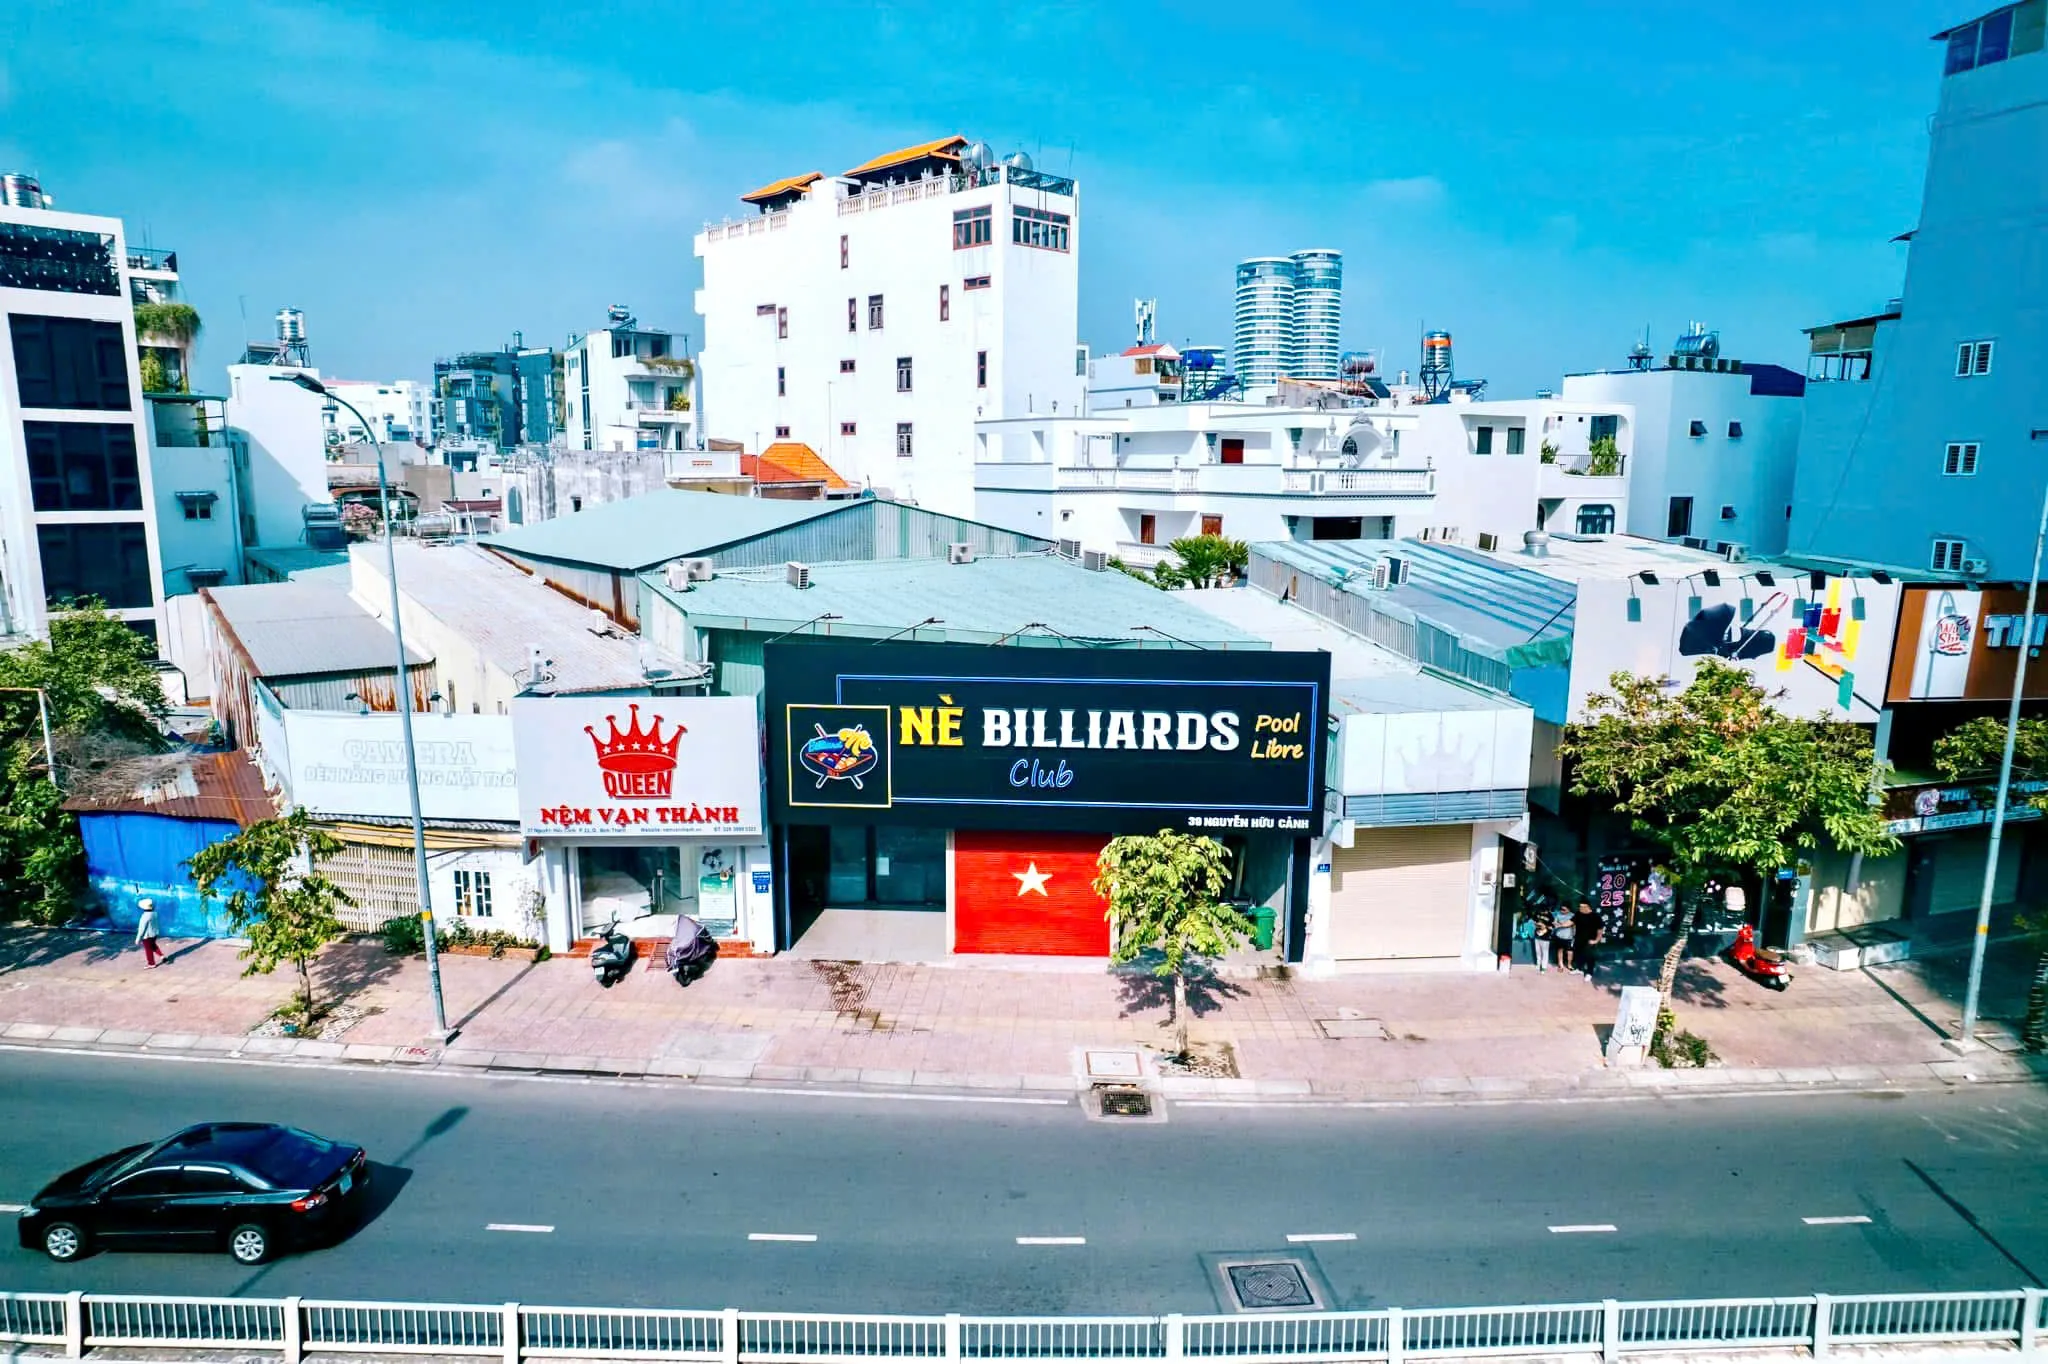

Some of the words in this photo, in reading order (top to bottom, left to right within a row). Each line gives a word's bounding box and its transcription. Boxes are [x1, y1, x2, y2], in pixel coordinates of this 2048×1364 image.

[899, 694, 965, 747] NÈ
[982, 707, 1240, 752] BILLIARDS
[1255, 712, 1300, 733] Pool
[343, 740, 477, 765] CAMERA
[1251, 737, 1304, 759] Libre
[602, 769, 671, 799] QUEEN
[1010, 758, 1074, 788] Club
[540, 804, 592, 828] NỆM
[597, 808, 650, 828] VẠN
[656, 802, 740, 824] THÀNH
[1203, 815, 1249, 828] NGUYỄN
[1251, 816, 1275, 829] HỮU
[1277, 816, 1309, 829] CẢNH
[1602, 874, 1625, 890] 20
[1601, 890, 1625, 907] 25
